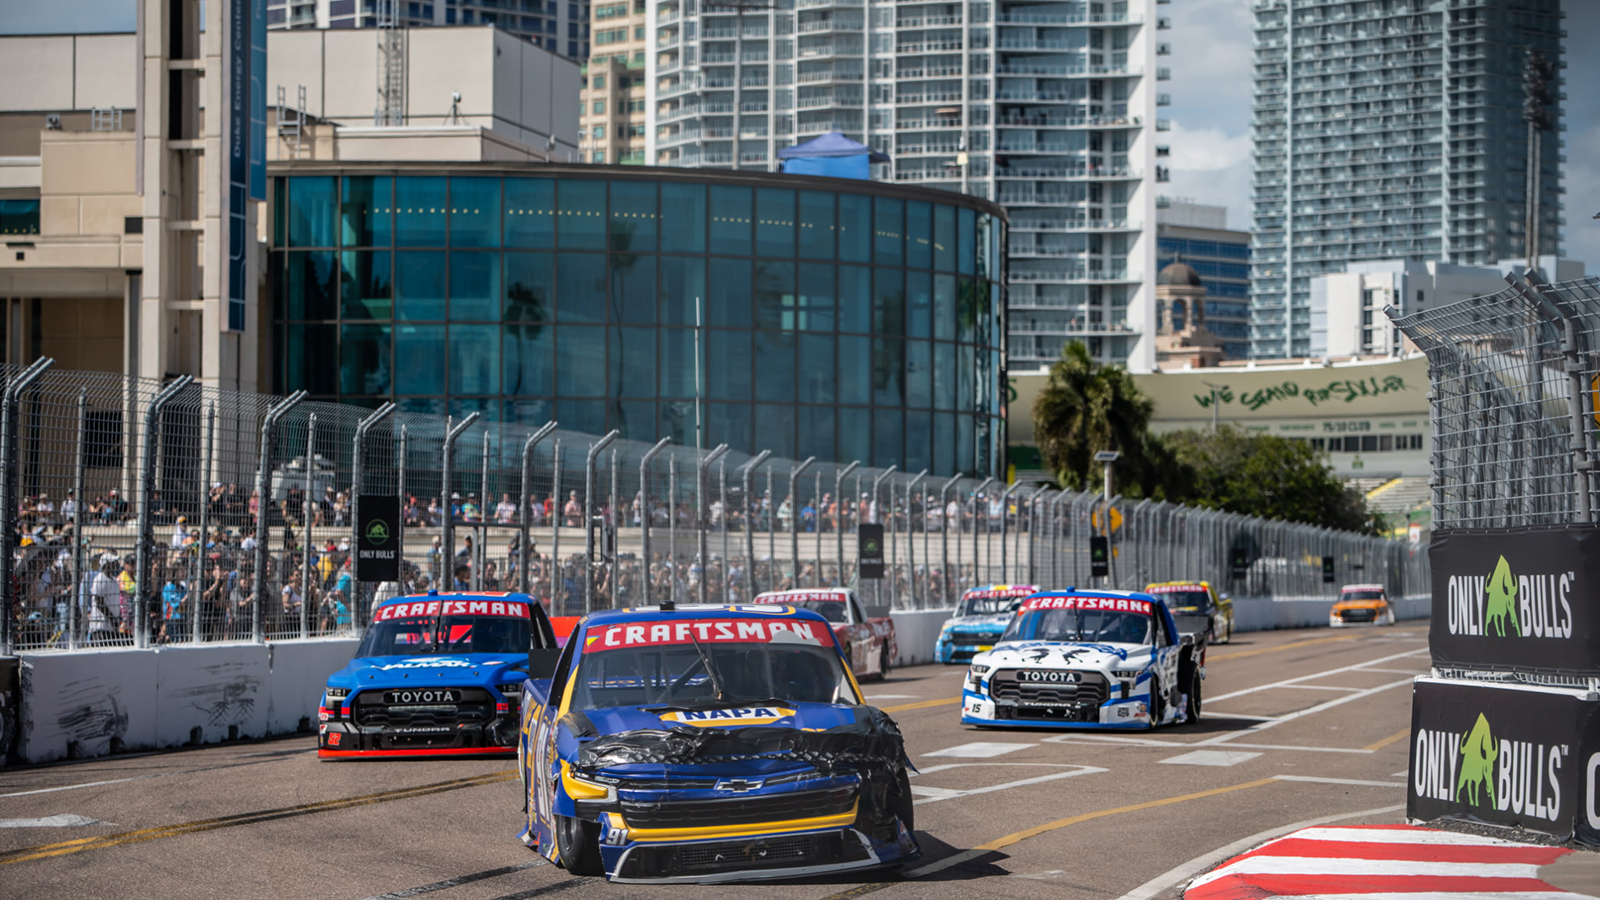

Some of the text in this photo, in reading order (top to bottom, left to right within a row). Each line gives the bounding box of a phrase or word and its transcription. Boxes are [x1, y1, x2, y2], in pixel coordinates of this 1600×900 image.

[234, 55, 243, 111] Energy
[360, 550, 374, 559] ONLY
[759, 592, 839, 604] CRAFTSMAN
[1029, 597, 1143, 612] CRAFTSMAN
[381, 601, 523, 620] CRAFTSMAN
[1448, 575, 1485, 636] ONLY
[1023, 671, 1076, 682] TOYOTA
[392, 691, 454, 703] TOYOTA
[682, 708, 777, 721] NAPA
[972, 704, 982, 713] 15
[328, 732, 341, 746] 52
[1415, 728, 1460, 802] ONLY
[606, 828, 629, 845] 91
